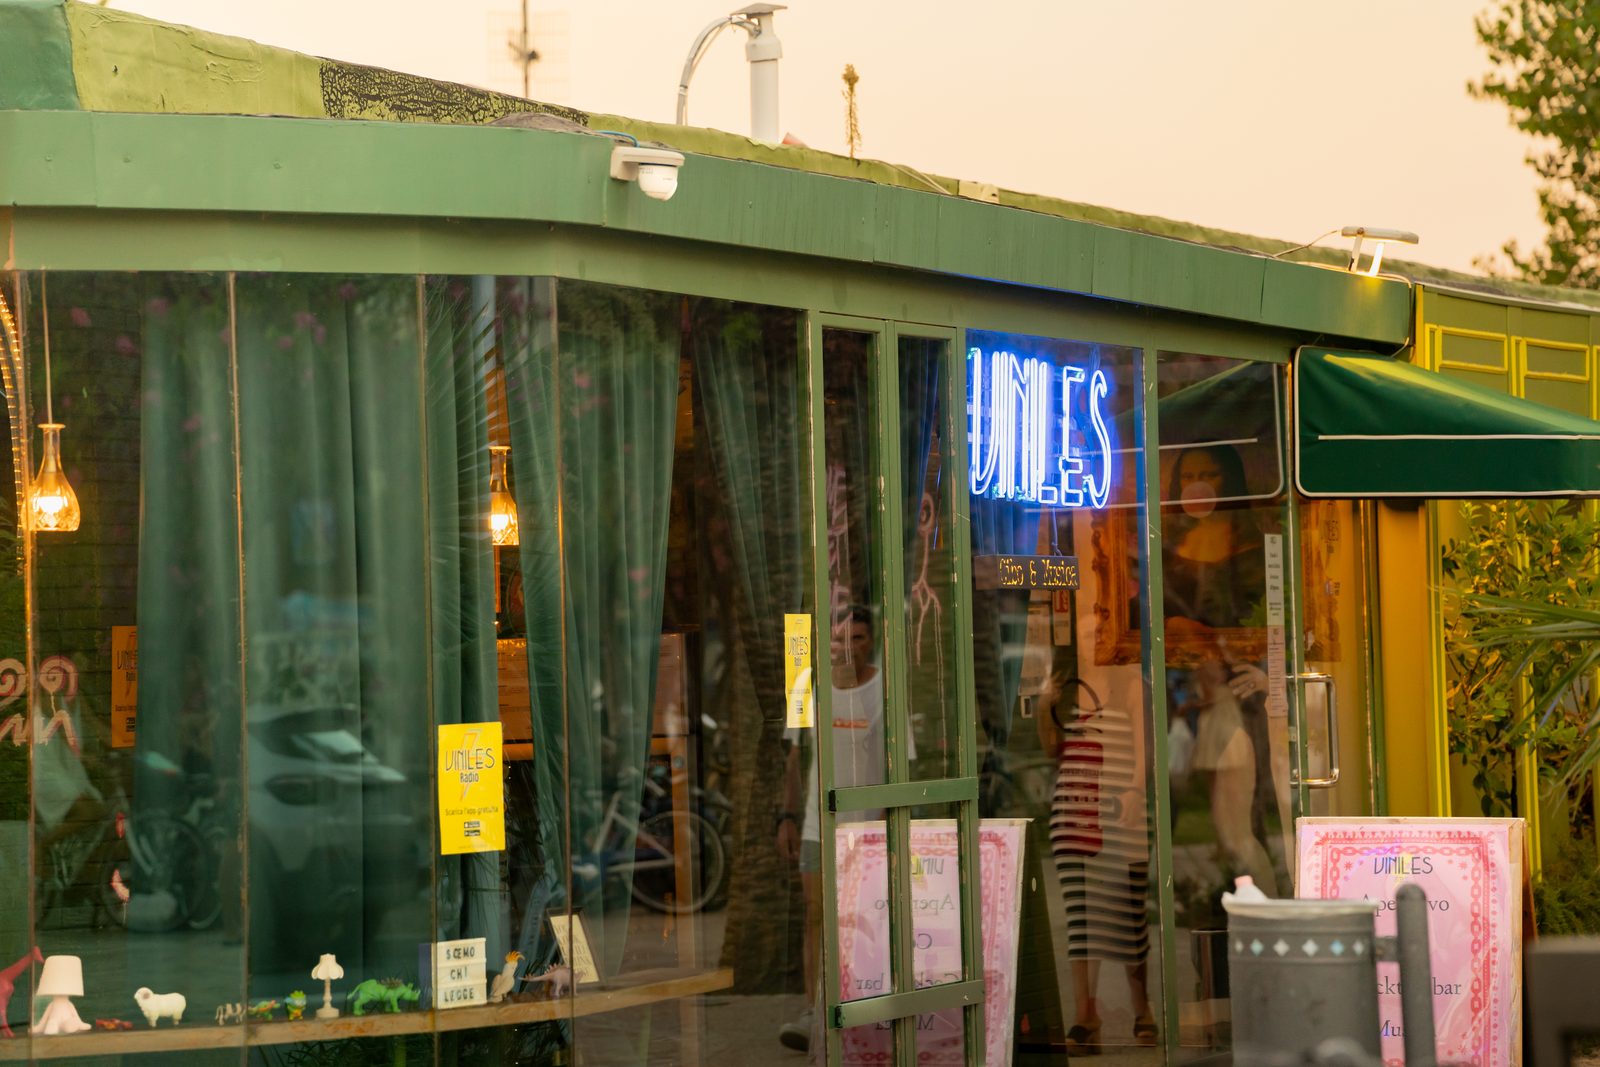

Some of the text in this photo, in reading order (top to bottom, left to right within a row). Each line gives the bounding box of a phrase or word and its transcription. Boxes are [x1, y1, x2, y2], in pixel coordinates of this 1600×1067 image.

[1029, 560, 1037, 586] &
[460, 771, 479, 783] Radio
[1373, 856, 1433, 875] VINILES
[1432, 976, 1462, 996] bar
